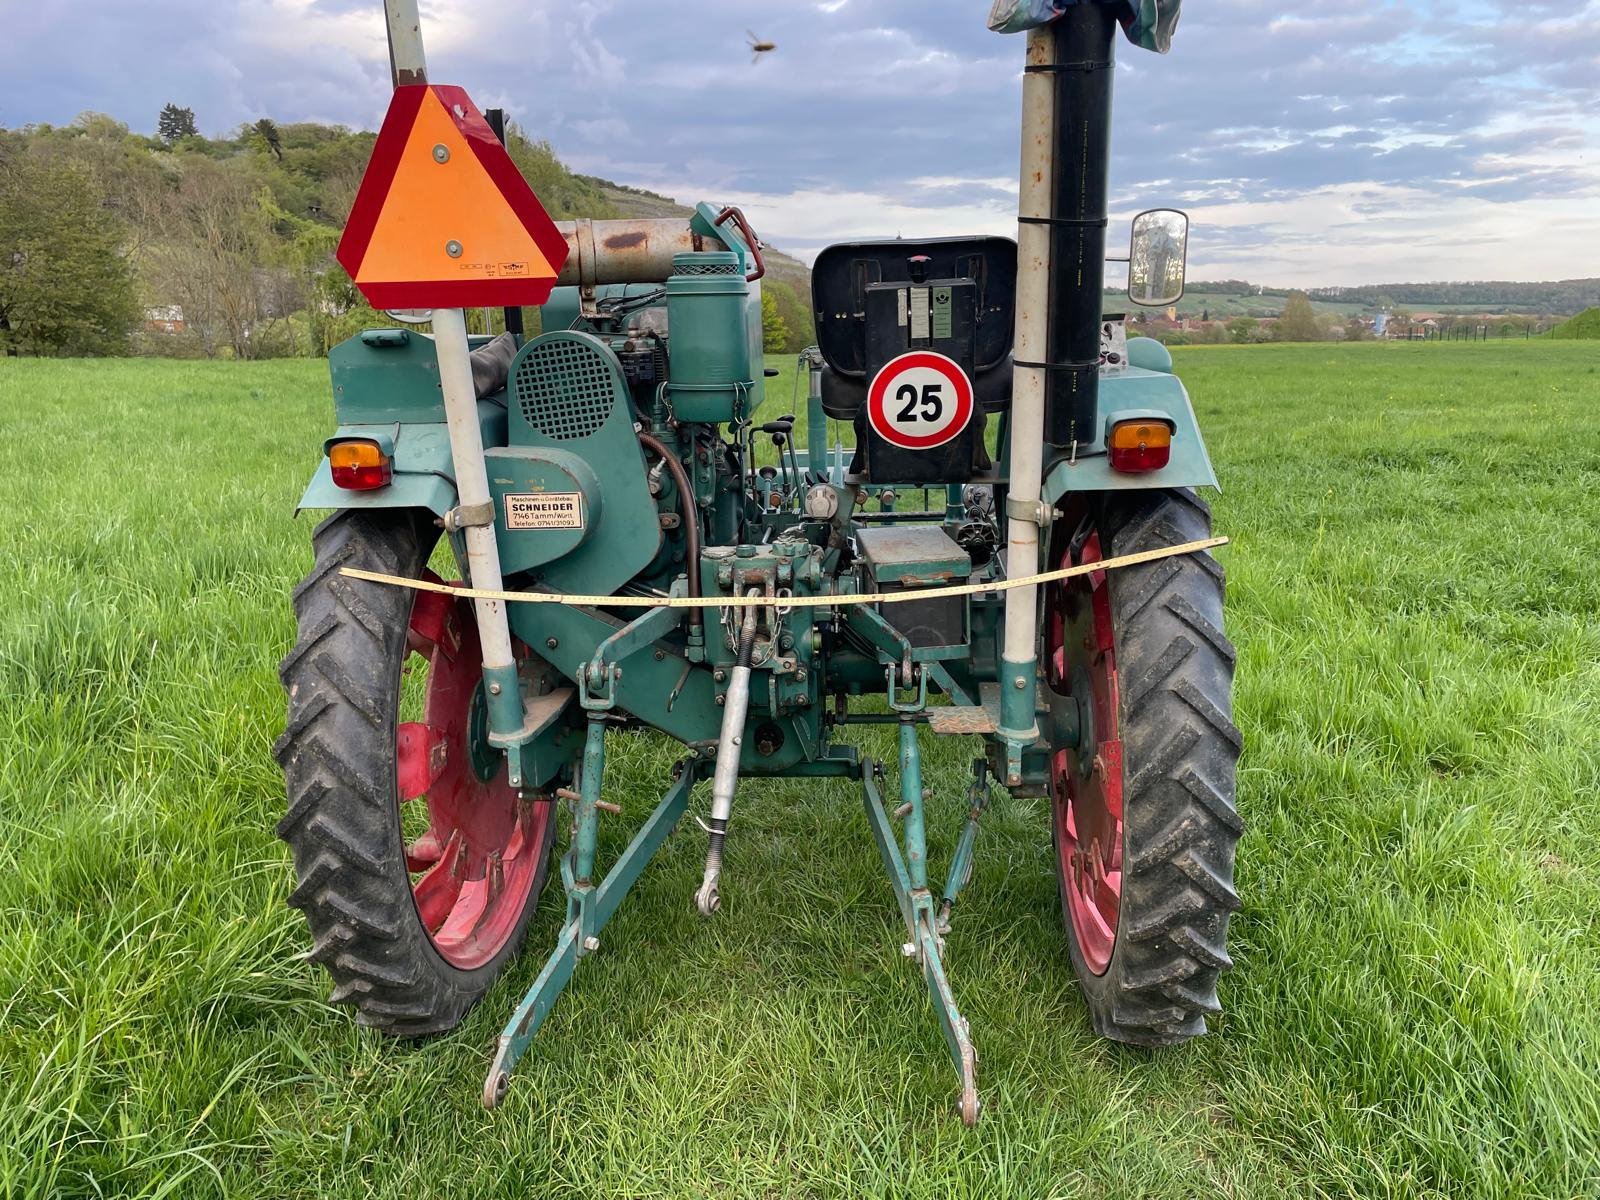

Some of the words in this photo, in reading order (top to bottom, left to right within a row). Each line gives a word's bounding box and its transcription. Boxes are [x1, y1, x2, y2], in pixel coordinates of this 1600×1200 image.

[896, 384, 942, 422] 25
[512, 503, 573, 512] SCHNEIDER
[512, 512, 530, 520] 7146
